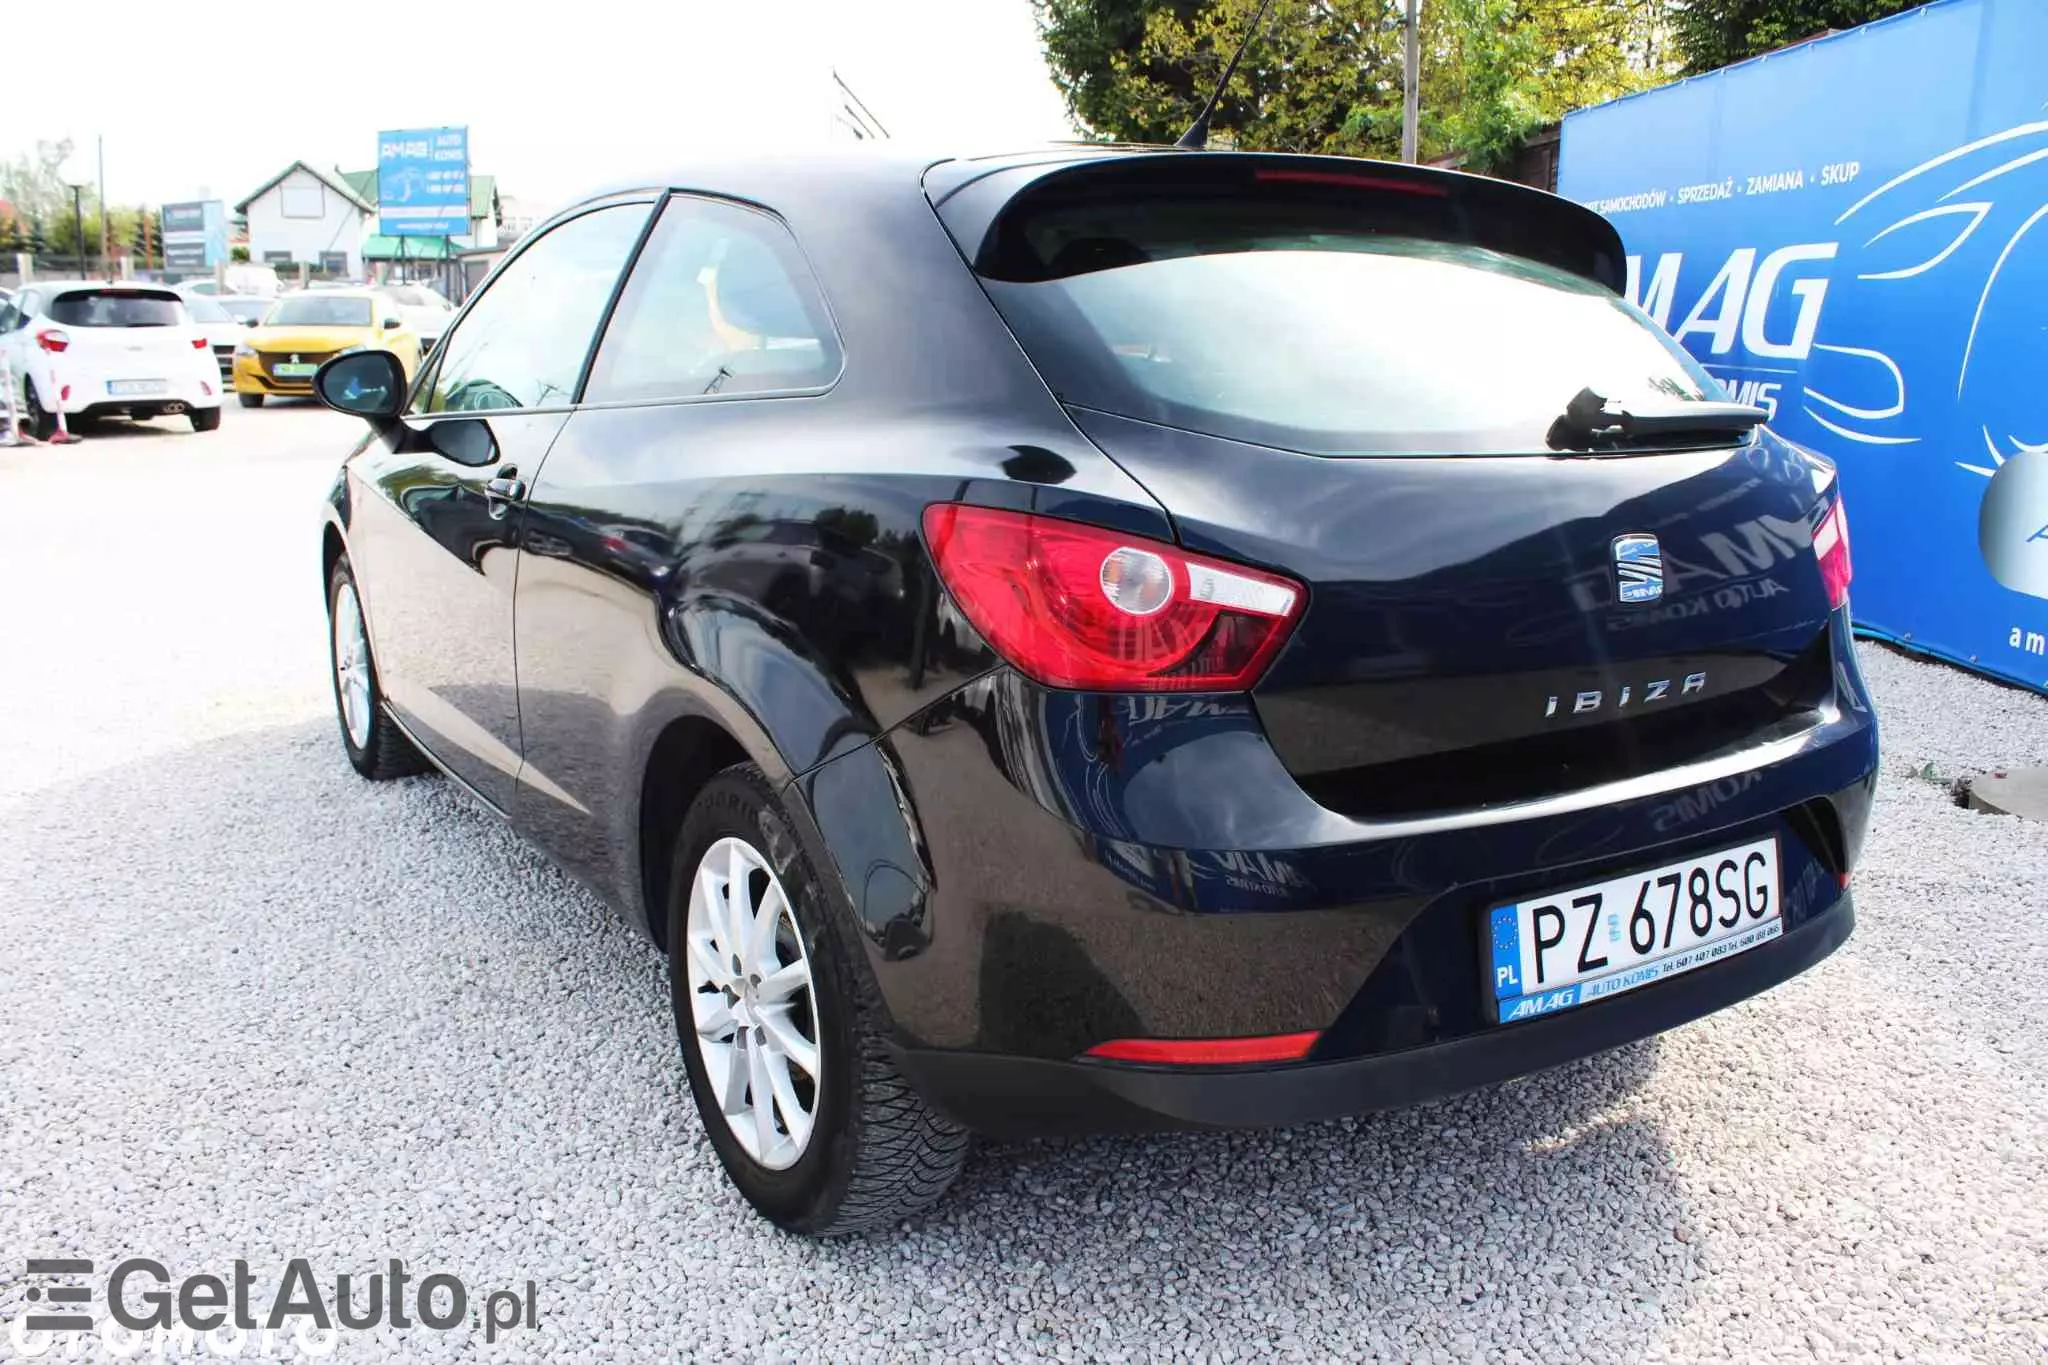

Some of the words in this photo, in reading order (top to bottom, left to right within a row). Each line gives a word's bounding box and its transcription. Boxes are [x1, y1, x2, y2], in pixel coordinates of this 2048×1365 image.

[1677, 176, 1734, 205] SPRZEDAŻ
[1745, 170, 1805, 197] ZAMIANA
[1820, 161, 1861, 186] SKUP
[1625, 242, 1839, 360] MAG
[1532, 893, 1608, 984] PZ
[1629, 851, 1768, 954] 678SG
[1496, 965, 1519, 988] PL
[1509, 988, 1576, 1020] AMAG
[1588, 978, 1621, 998] AUTO
